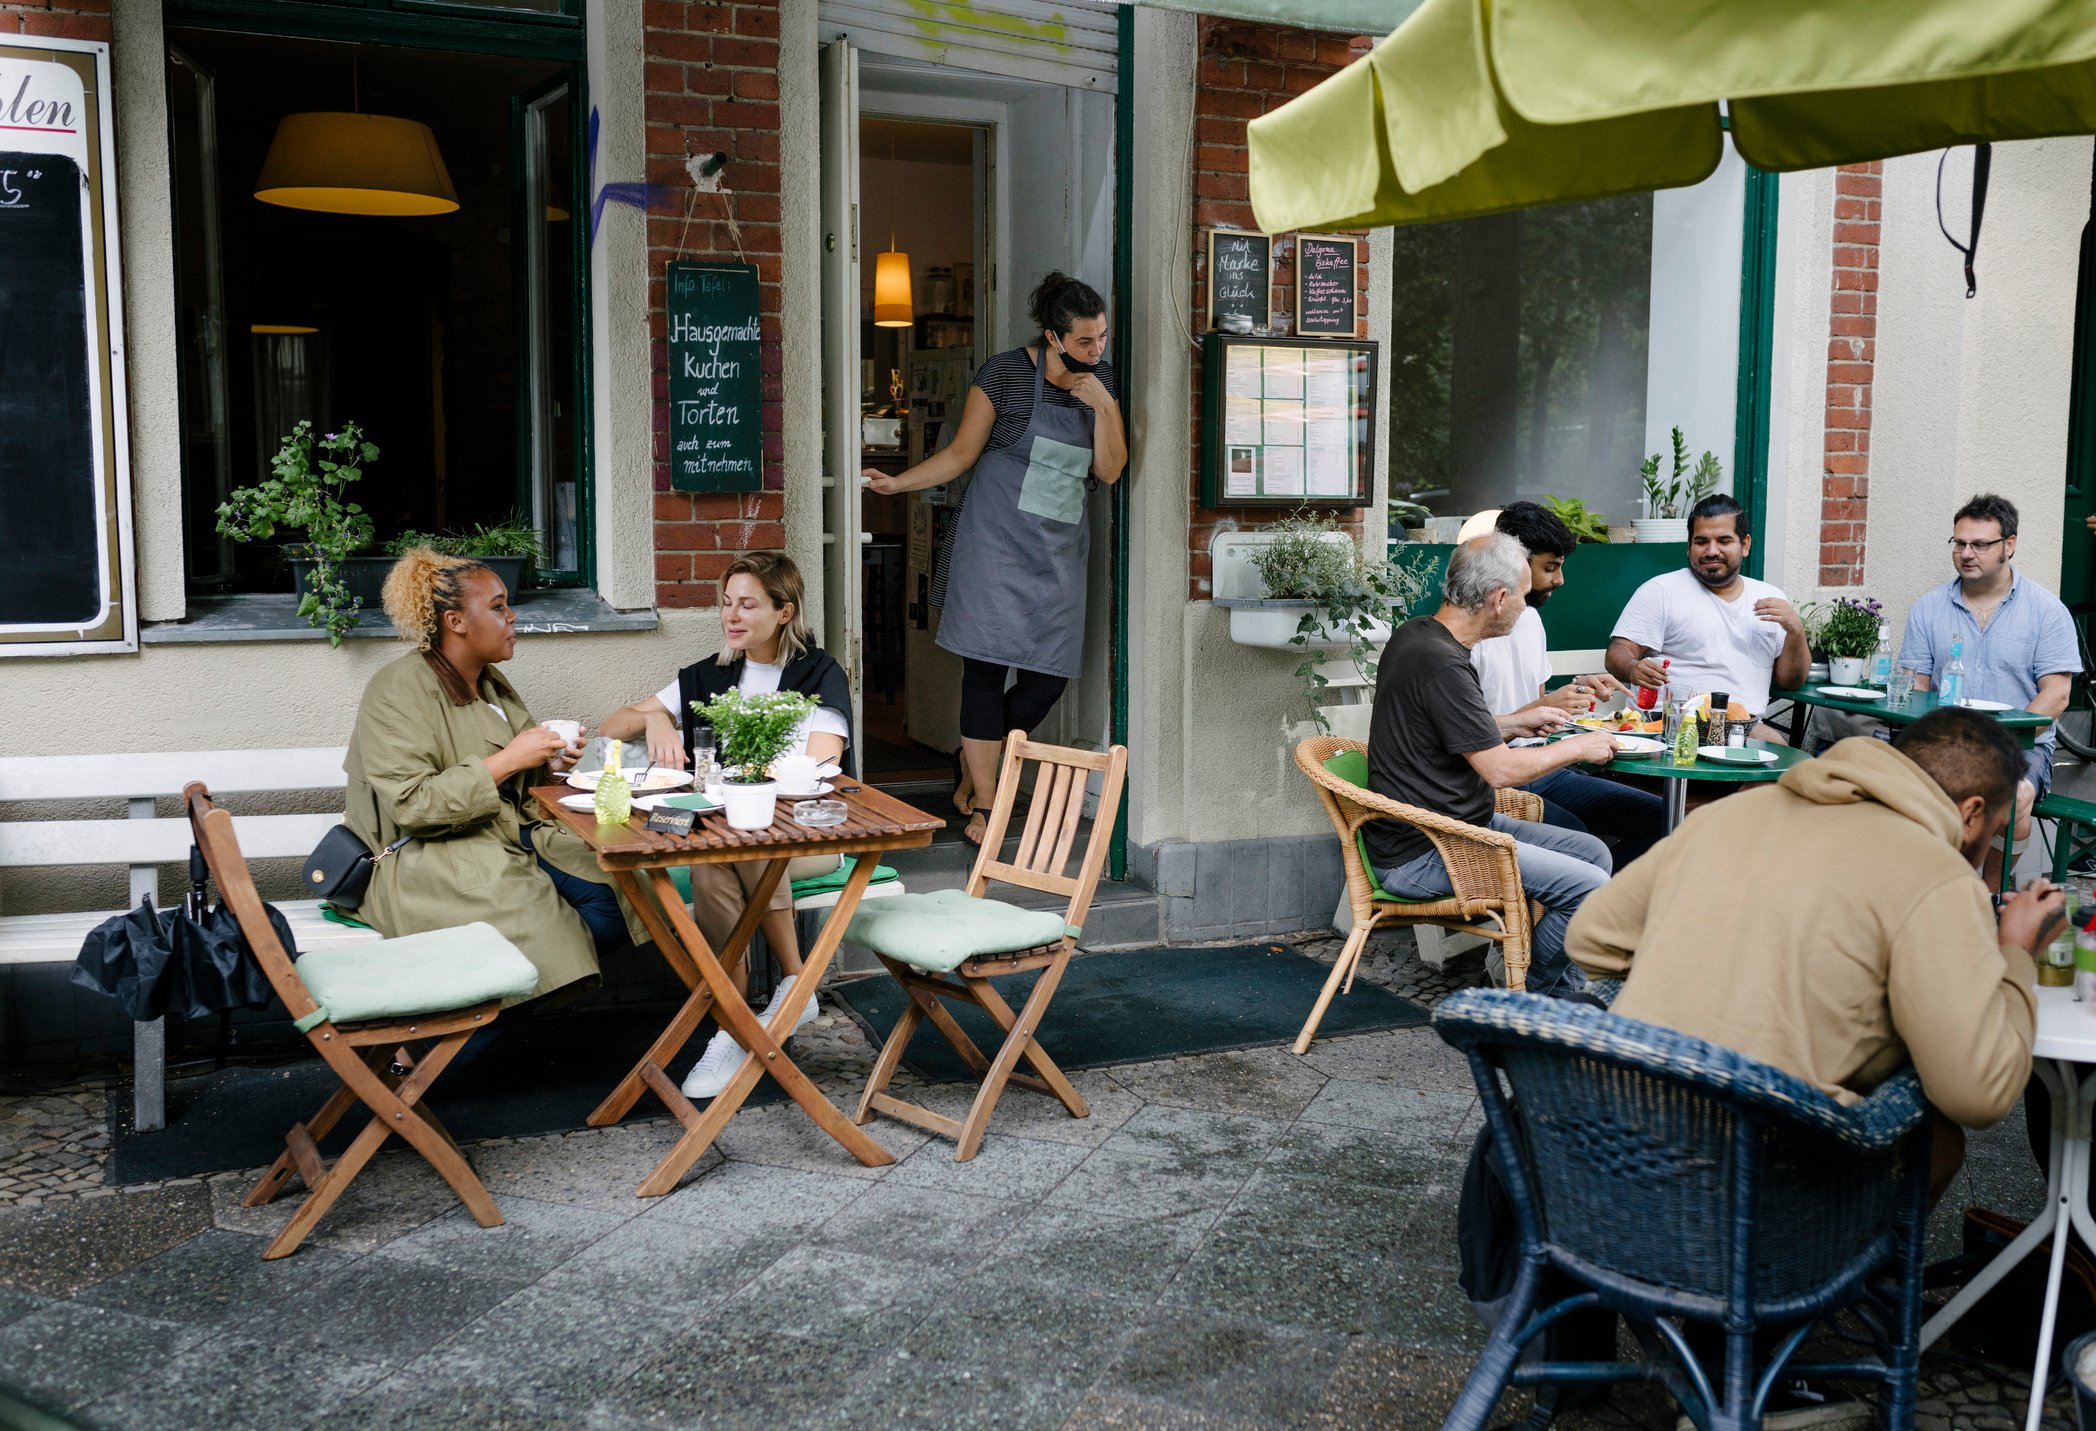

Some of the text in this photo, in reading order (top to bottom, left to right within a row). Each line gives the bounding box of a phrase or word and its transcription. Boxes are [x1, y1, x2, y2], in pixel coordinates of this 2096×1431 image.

[0, 73, 76, 127] len
[1231, 238, 1252, 253] Mit
[1304, 242, 1336, 258] Dalgona
[1218, 250, 1260, 273] Maske
[1315, 256, 1349, 270] Eiskaffee
[1229, 271, 1244, 280] ins
[674, 274, 695, 299] Info
[1219, 281, 1255, 299] Glück
[670, 313, 761, 356] Hausgemachte
[684, 351, 740, 379] Kuchen
[697, 382, 719, 397] und
[677, 400, 740, 425] Torten
[676, 434, 732, 451] auch zum
[683, 452, 753, 474] mitnehmen
[649, 812, 690, 826] Reserviert
